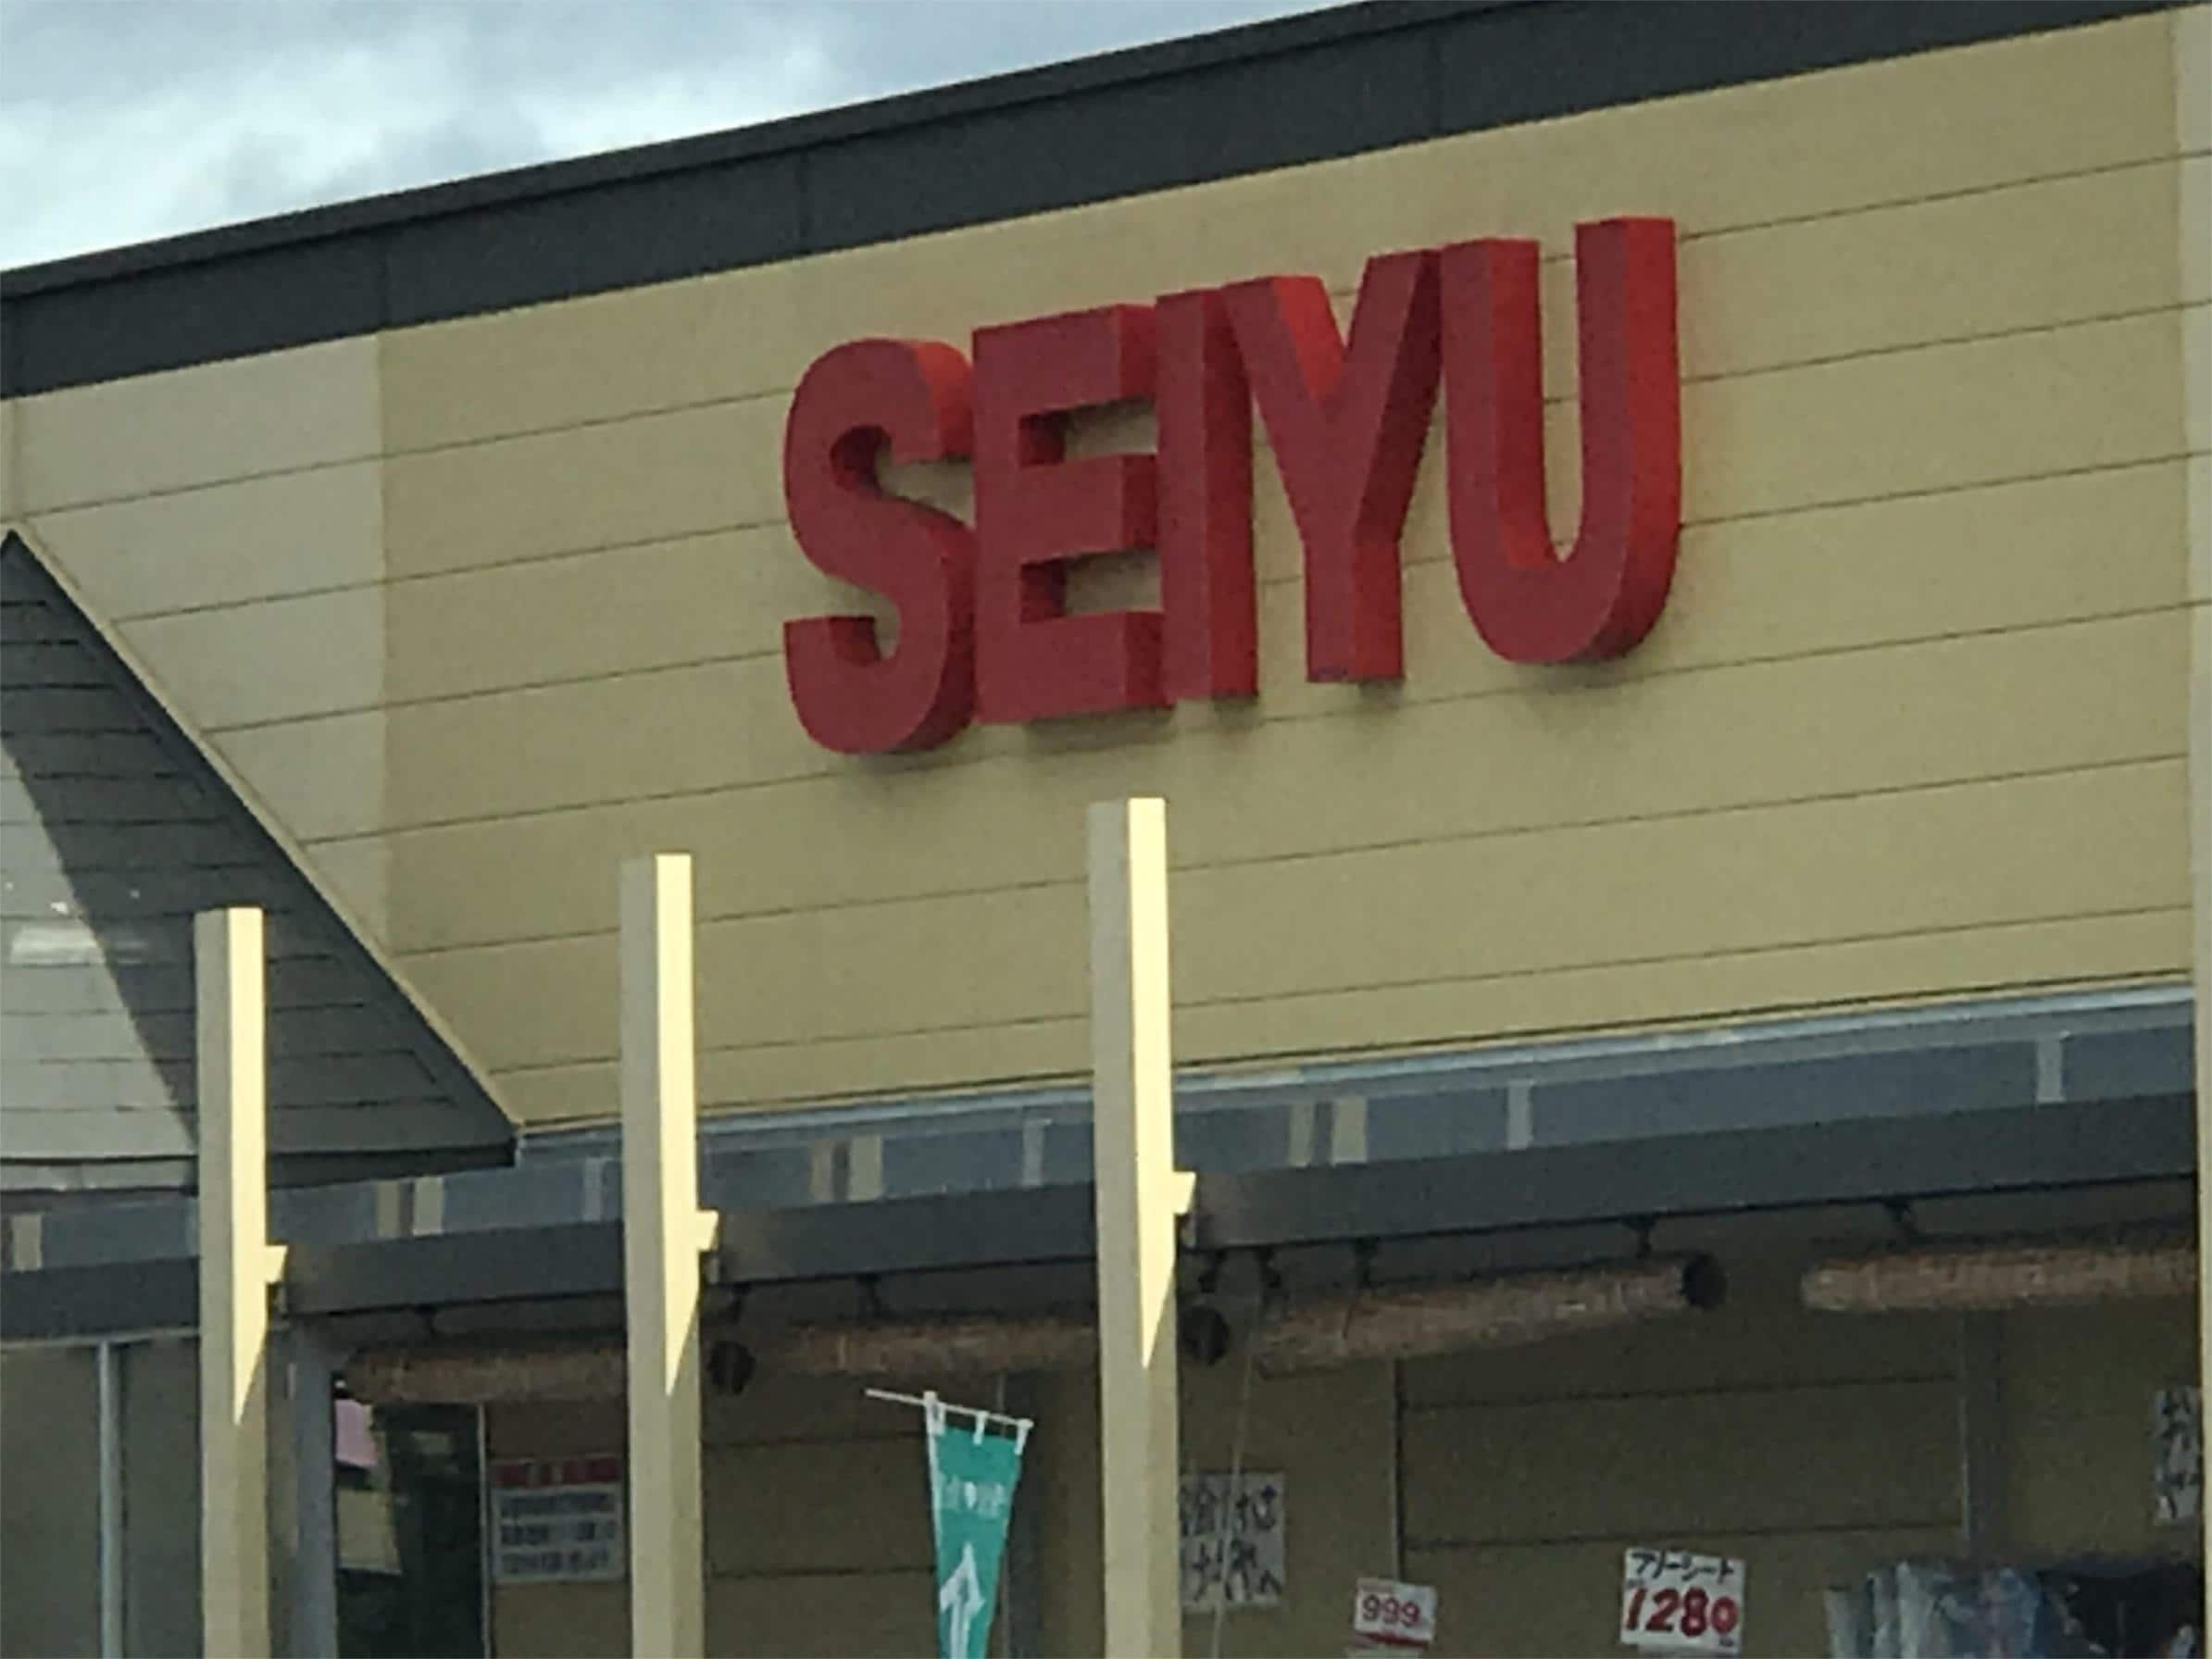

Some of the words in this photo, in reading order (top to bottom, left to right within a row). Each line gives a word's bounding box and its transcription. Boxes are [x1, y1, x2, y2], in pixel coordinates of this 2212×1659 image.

[783, 217, 1681, 755] SEIYU
[1362, 1593, 1419, 1628] 999
[1626, 1586, 1739, 1638] 1280
